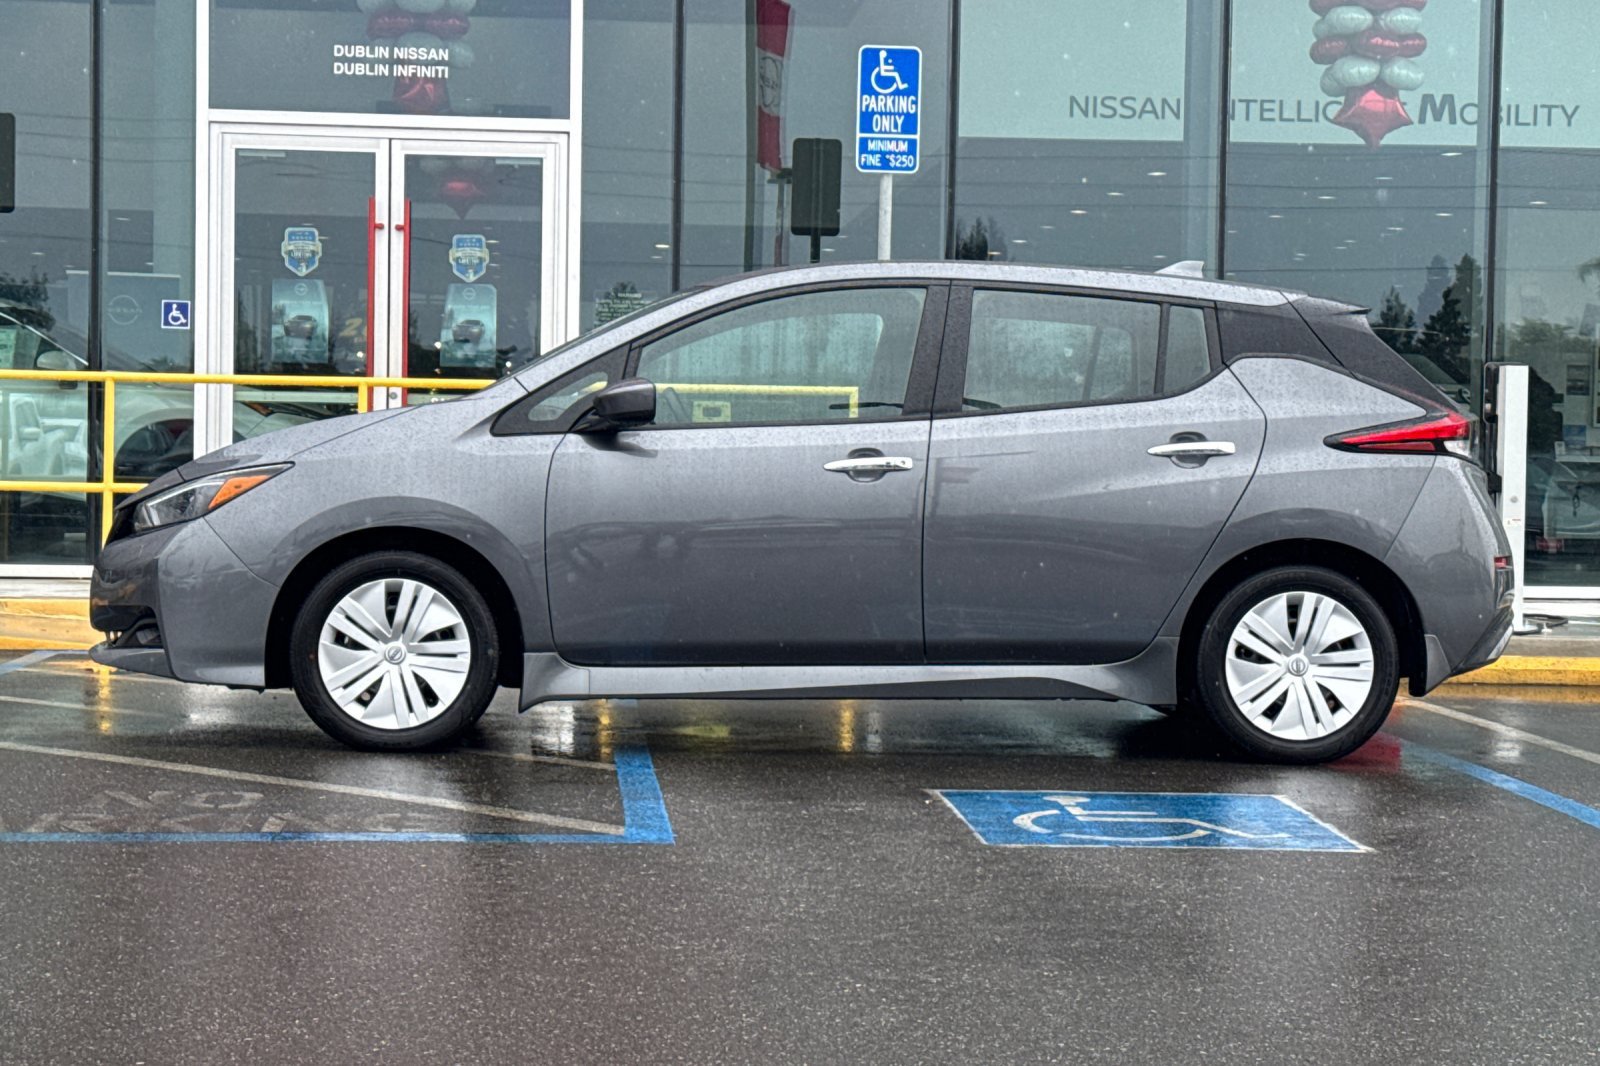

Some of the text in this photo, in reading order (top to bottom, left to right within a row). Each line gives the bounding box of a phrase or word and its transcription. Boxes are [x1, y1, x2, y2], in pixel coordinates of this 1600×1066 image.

[333, 44, 449, 61] DUBLIN NISSAN
[333, 62, 449, 79] DUBLIN INFINITI
[861, 94, 917, 114] PARKING
[1068, 95, 1182, 120] NISSAN
[1418, 93, 1580, 127] MOILITY
[872, 114, 905, 133] ONLY
[867, 139, 909, 153] MINIMUM
[861, 153, 882, 167] FINE
